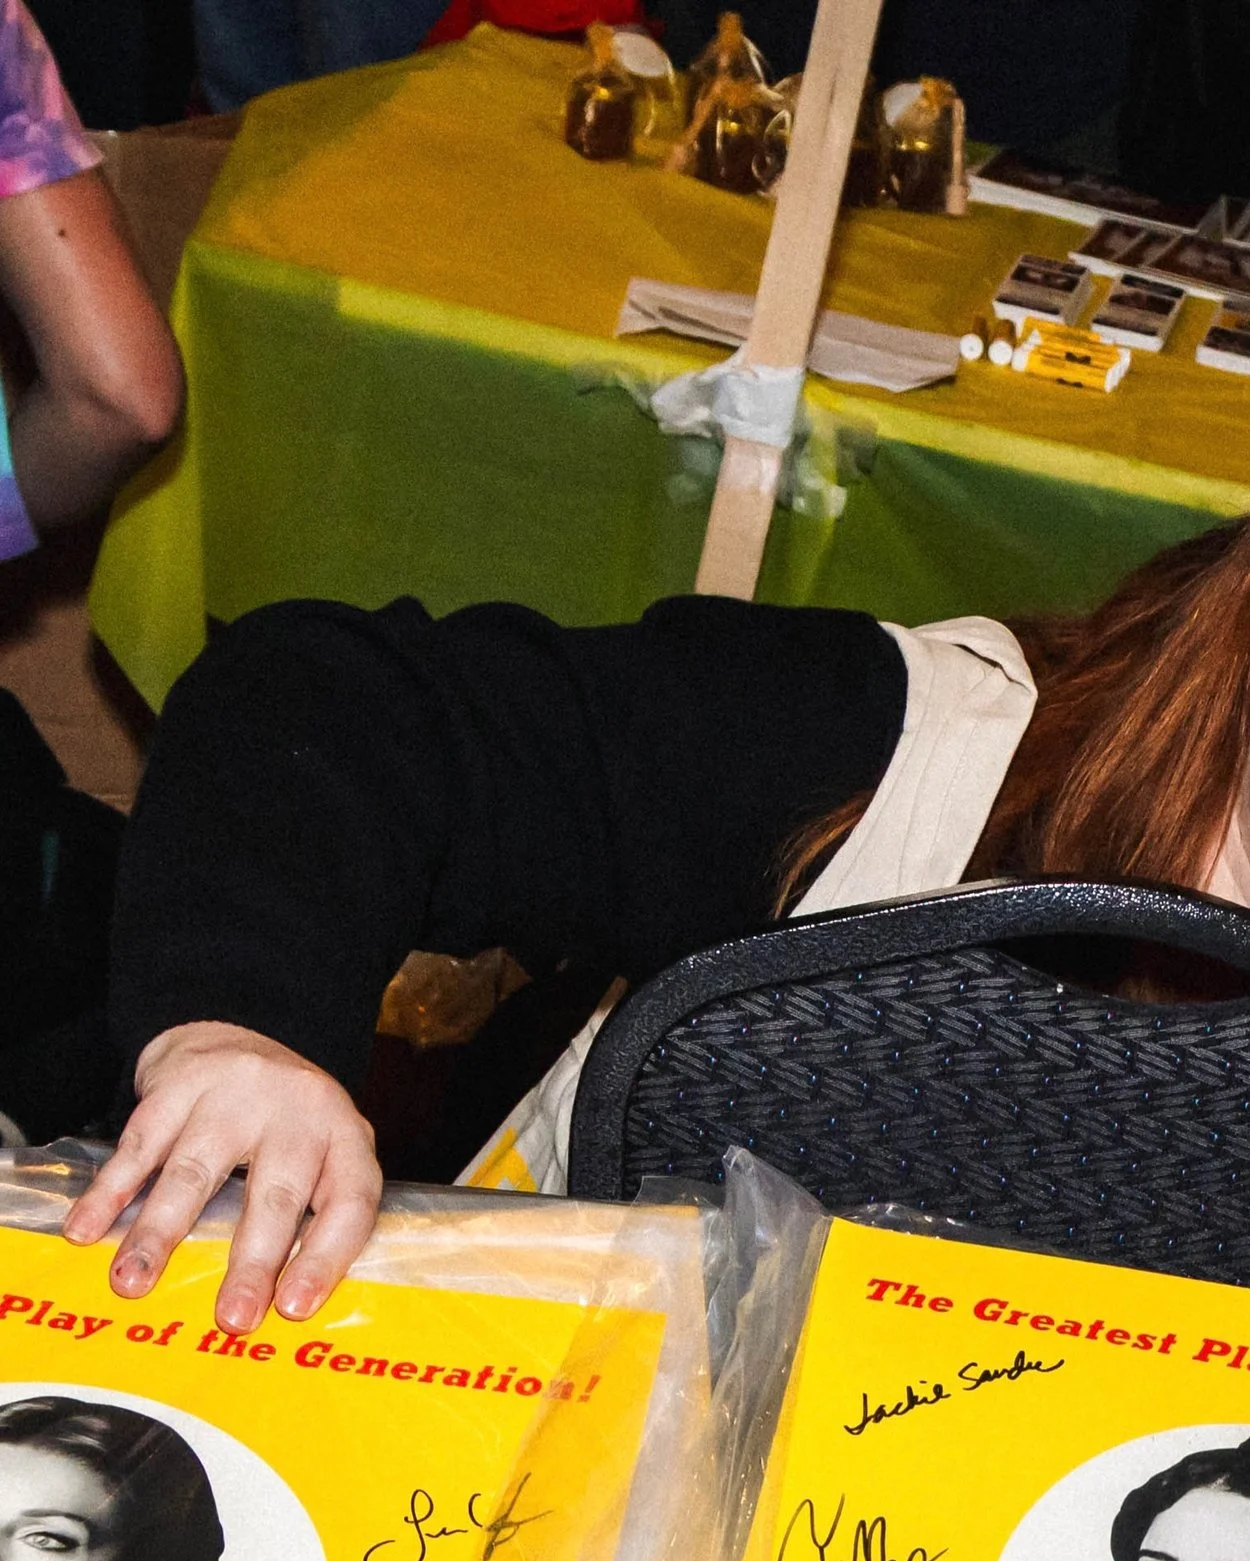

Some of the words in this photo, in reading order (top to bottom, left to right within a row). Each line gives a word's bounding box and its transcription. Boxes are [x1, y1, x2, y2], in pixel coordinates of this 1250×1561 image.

[0, 1284, 125, 1340] Play
[126, 1321, 184, 1346] of
[196, 1328, 277, 1362] the
[294, 1340, 599, 1401] Generation!
[867, 1278, 954, 1313] The
[973, 1297, 1177, 1355] Greatest
